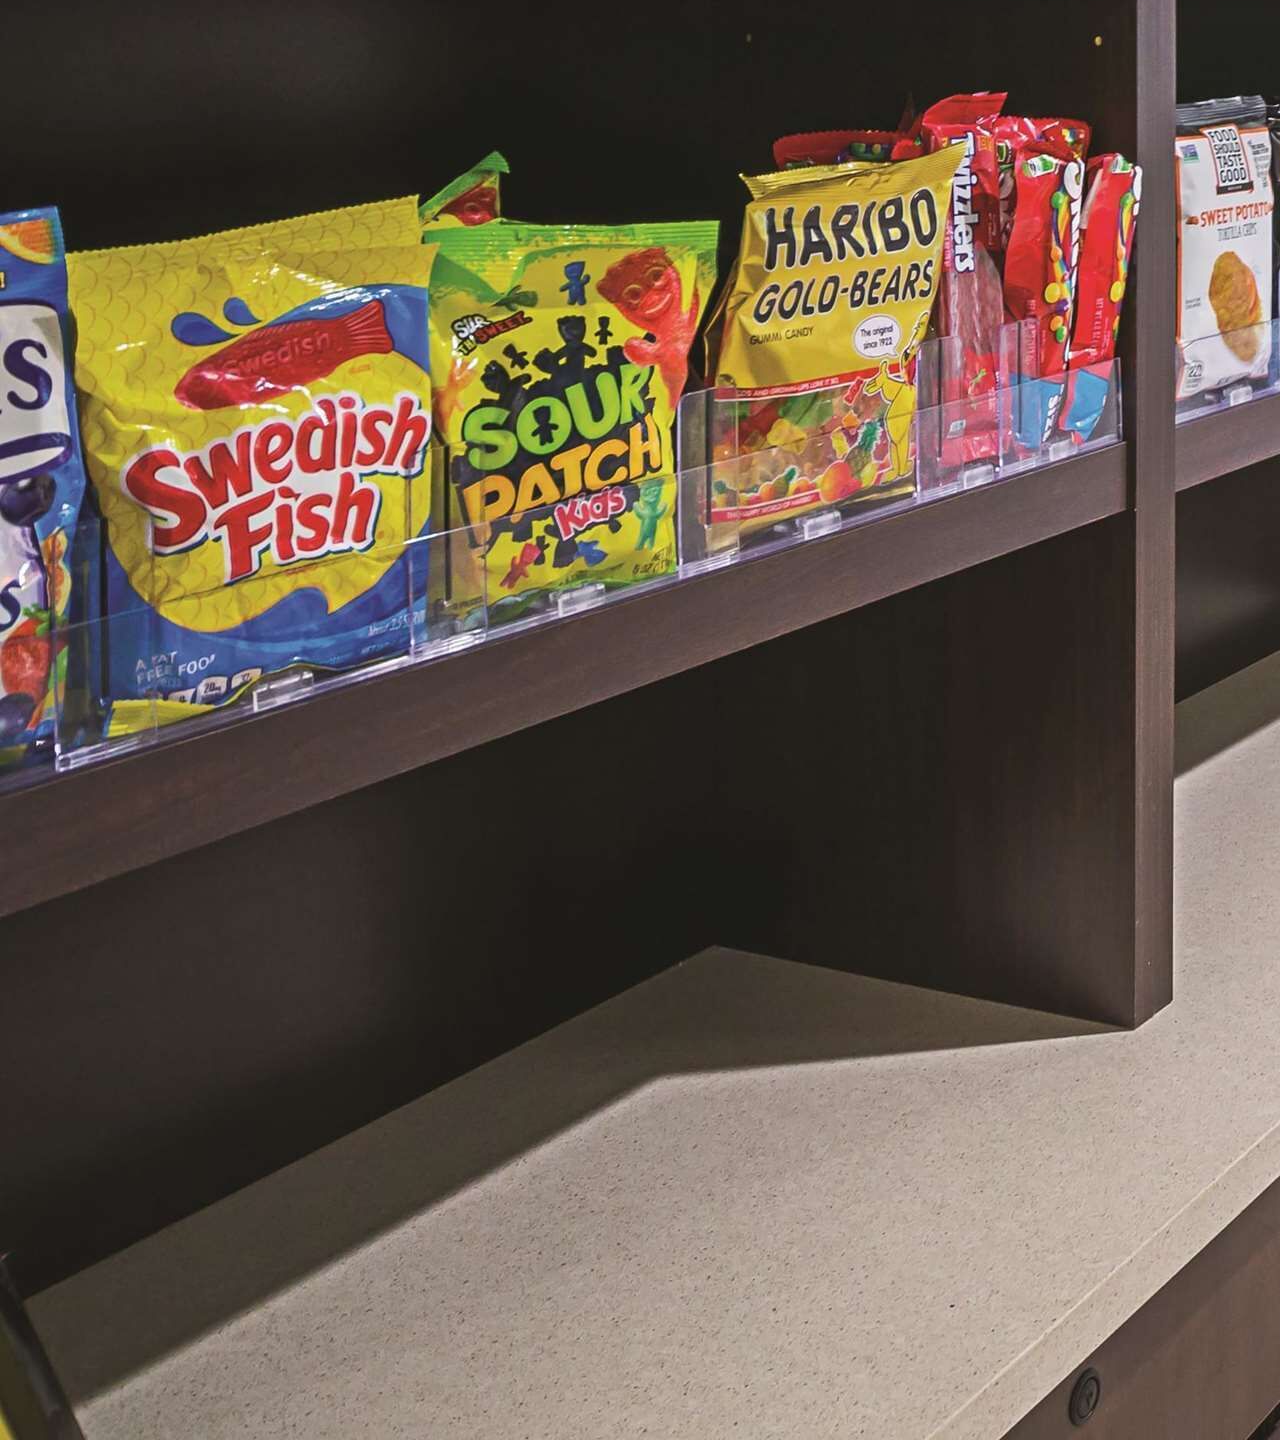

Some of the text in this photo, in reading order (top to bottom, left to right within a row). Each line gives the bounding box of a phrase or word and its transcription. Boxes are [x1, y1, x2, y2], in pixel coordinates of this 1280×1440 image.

[1208, 127, 1238, 144] FOOD
[1214, 141, 1241, 155] SHOULD
[1218, 153, 1243, 169] TASTE
[1219, 166, 1247, 184] GOOD
[950, 131, 981, 273] Twizzlers
[1199, 202, 1271, 228] SWEET POTATO
[763, 186, 938, 271] HARIBO
[752, 258, 934, 324] GOLD-BEARS
[749, 326, 814, 346] GUMMI CANDY
[860, 325, 894, 338] The original
[879, 336, 893, 348] 1922
[462, 363, 651, 471] SOUR
[124, 398, 431, 547] Swedish
[463, 412, 662, 548] PATCH
[212, 482, 378, 581] Fish
[554, 488, 625, 541] Kids
